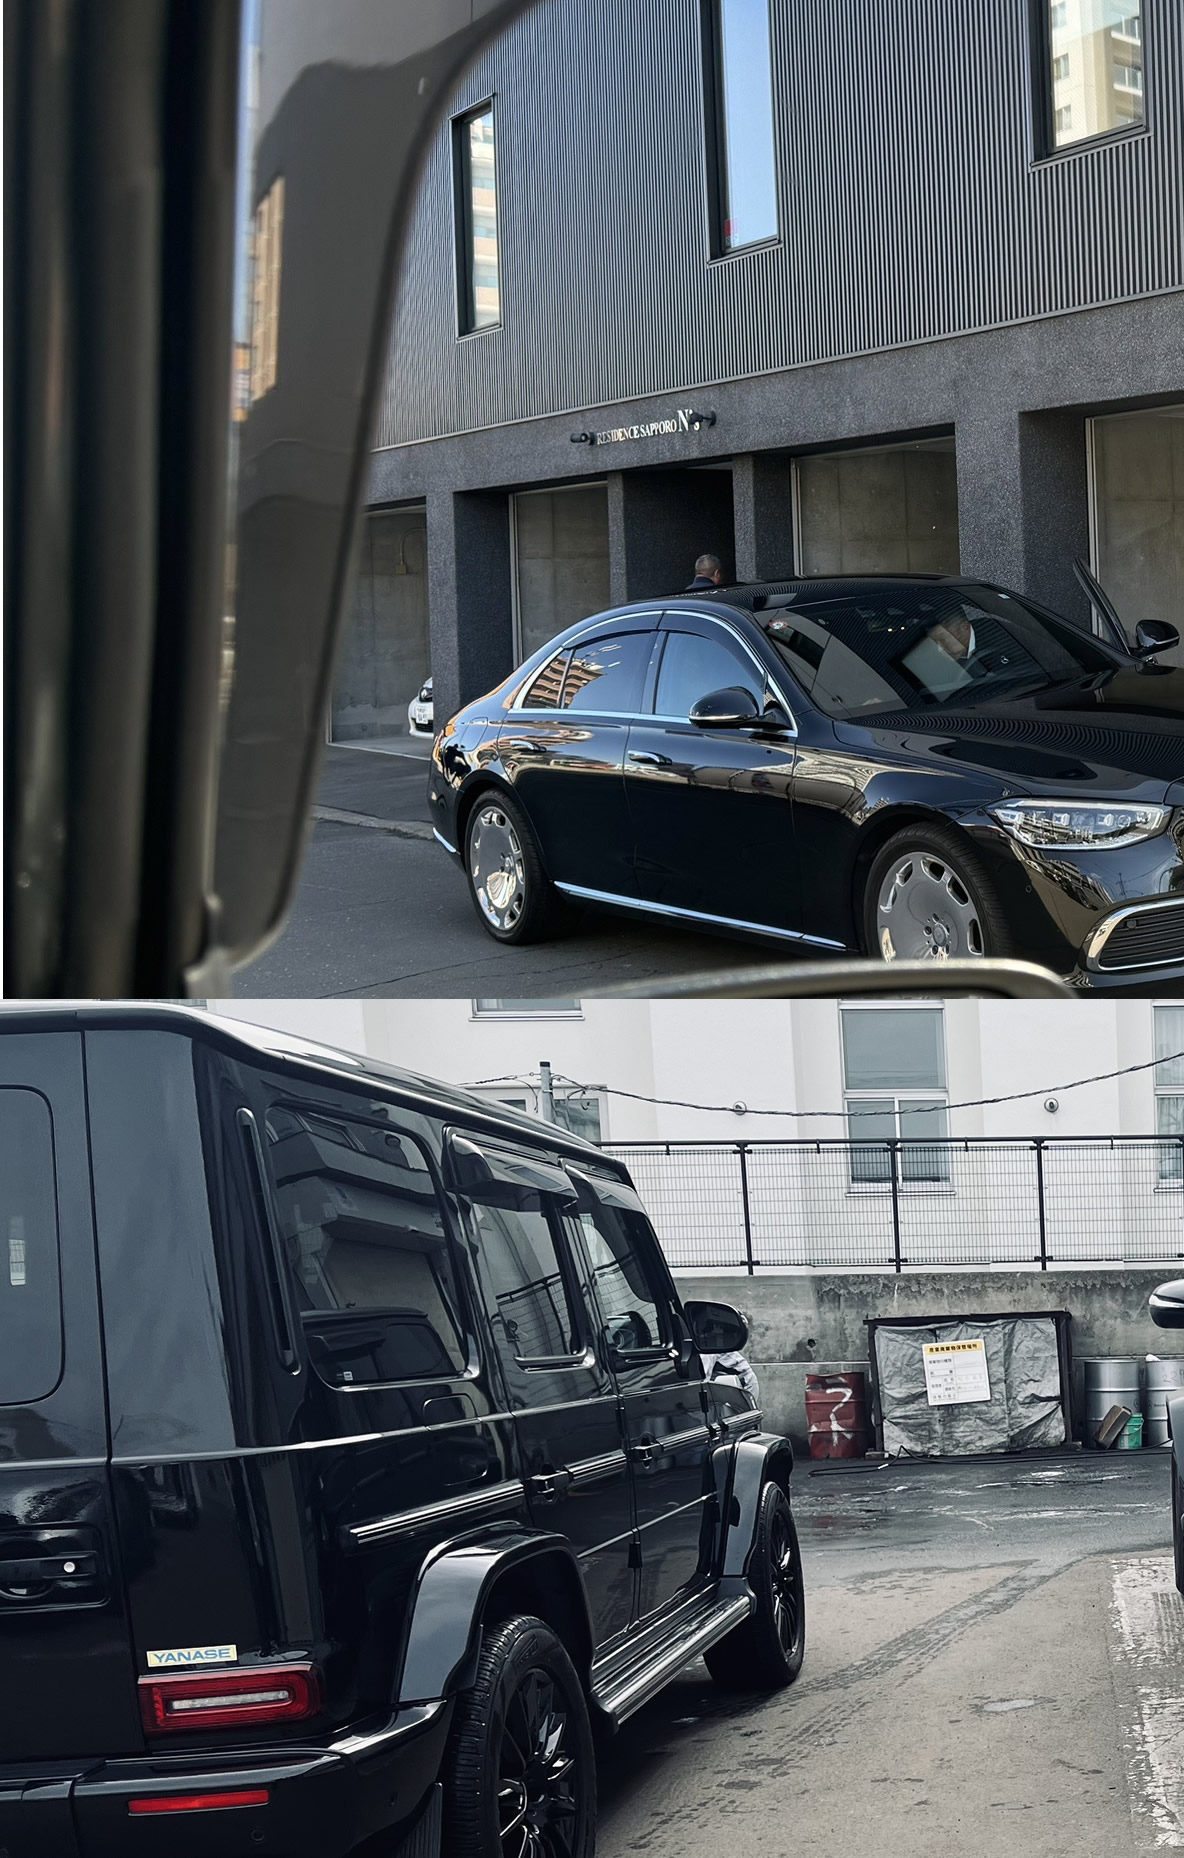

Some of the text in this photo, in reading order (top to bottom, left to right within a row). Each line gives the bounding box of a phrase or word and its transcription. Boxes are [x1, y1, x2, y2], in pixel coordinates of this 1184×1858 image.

[596, 425, 640, 445] RESIDENCE
[640, 419, 677, 437] SAPPORO
[153, 1648, 232, 1664] YANASE
